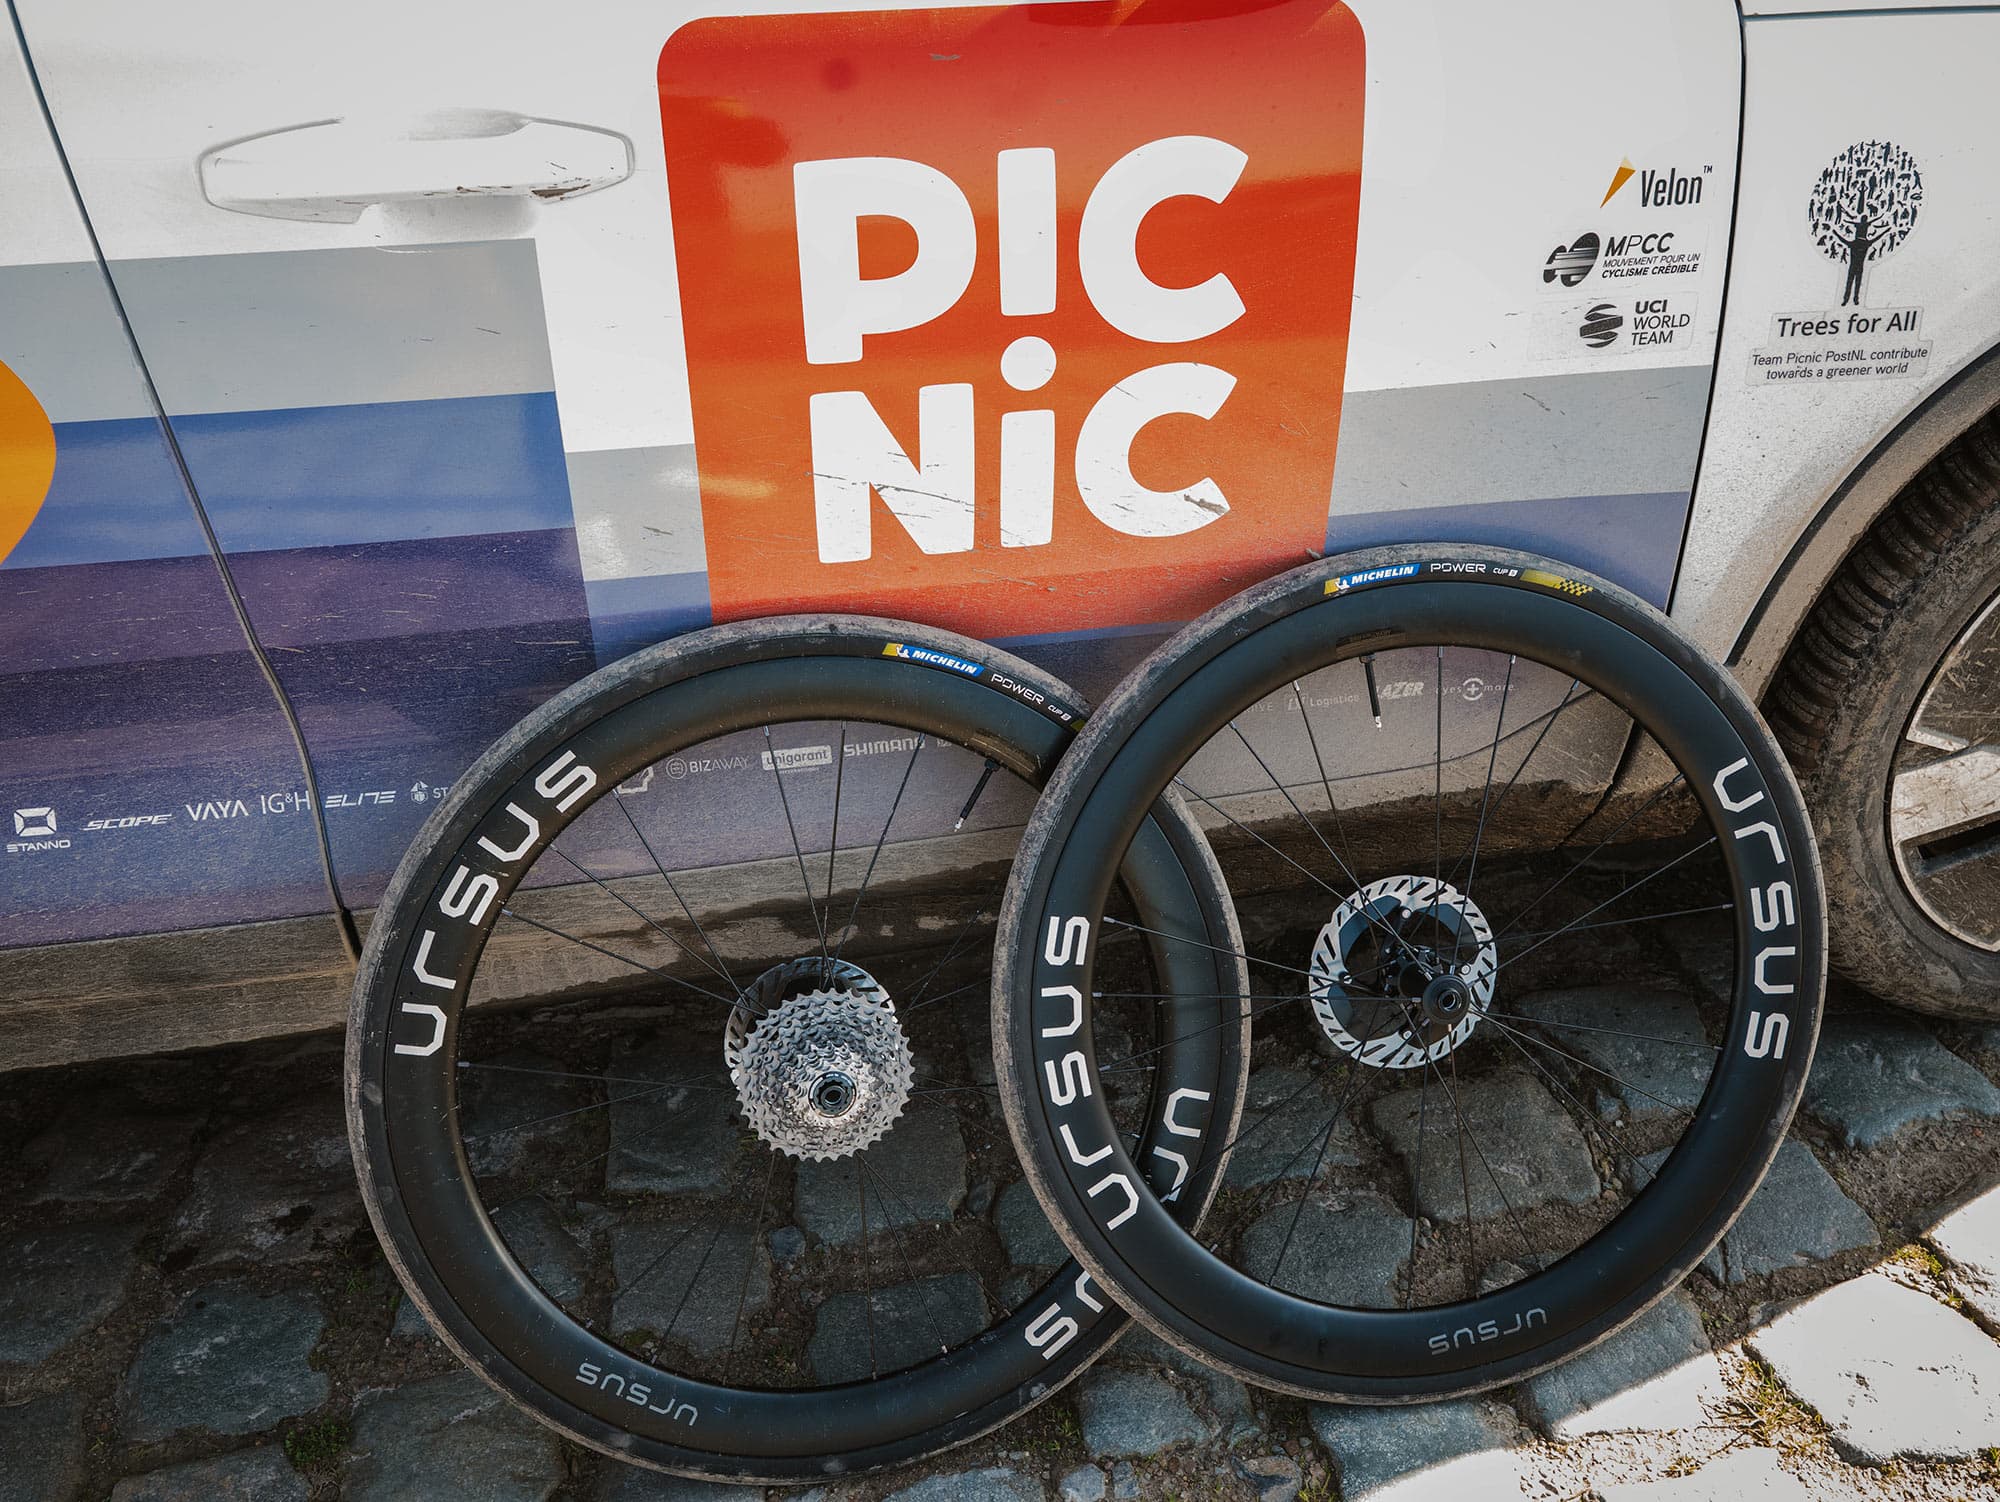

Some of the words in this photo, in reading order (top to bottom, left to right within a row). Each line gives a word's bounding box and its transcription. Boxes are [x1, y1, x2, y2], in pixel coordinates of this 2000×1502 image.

[793, 134, 1249, 365] PIC
[1604, 232, 1675, 257] MPCC
[1602, 255, 1659, 268] MOUVEMENT
[1660, 254, 1685, 264] POUR
[1687, 253, 1701, 262] UN
[1601, 266, 1650, 279] CYCLISME
[1651, 263, 1699, 276] CRÉDIBLE
[1634, 299, 1668, 314] UCI
[1633, 313, 1691, 330] WORLD
[1777, 318, 1841, 338] Trees
[1847, 313, 1882, 334] for
[1886, 310, 1918, 332] All
[1631, 330, 1674, 346] TEAM
[1752, 354, 1783, 366] Team
[1786, 351, 1822, 364] Picnic
[1825, 350, 1867, 362] PostNL
[1870, 347, 1928, 361] contribute
[1766, 366, 1813, 380] towards
[1816, 368, 1823, 377] a
[1826, 366, 1872, 379] greener
[1875, 362, 1909, 375] world
[1350, 566, 1414, 585] MICHELIN
[1430, 562, 1487, 574] POWER
[911, 649, 978, 675] MICHELIN
[990, 673, 1045, 705] POWER
[842, 737, 926, 757] SHIMANO
[689, 756, 750, 773] BIZAWAY
[766, 749, 829, 766] unigarant
[260, 790, 311, 815] IG&H
[325, 790, 397, 809] ELITE
[80, 813, 173, 831] SCOPE
[6, 839, 71, 853] STANNO
